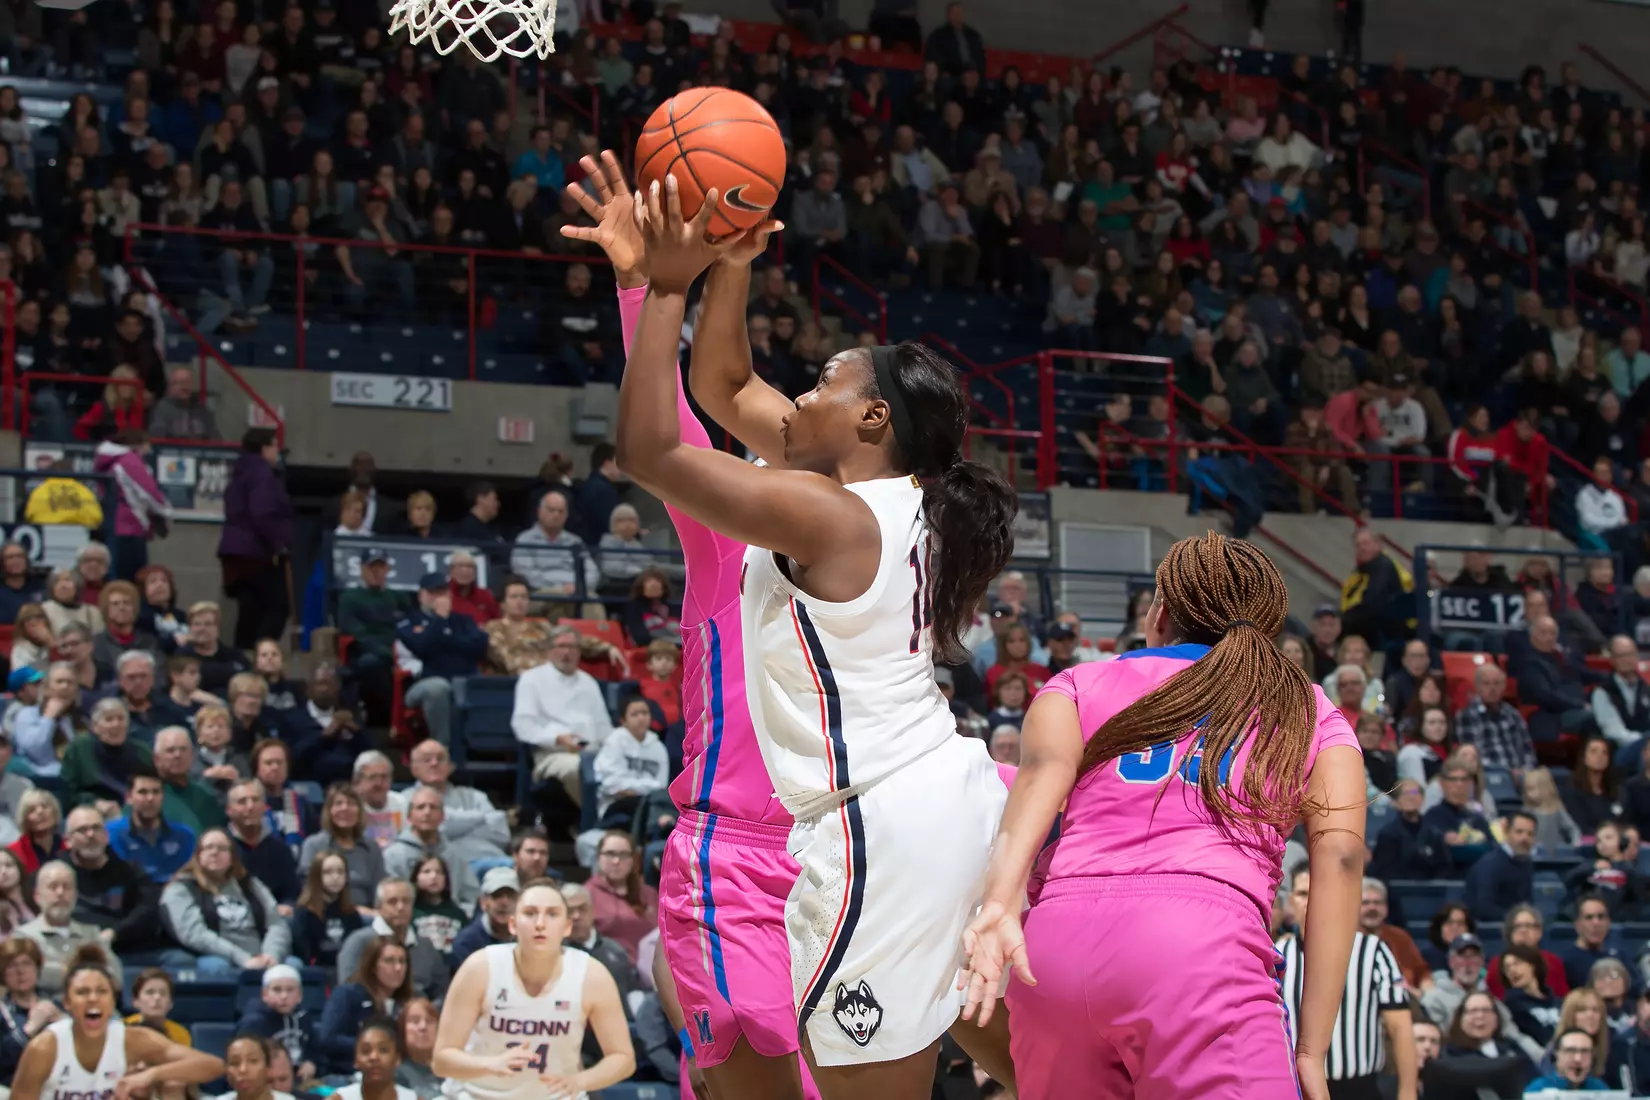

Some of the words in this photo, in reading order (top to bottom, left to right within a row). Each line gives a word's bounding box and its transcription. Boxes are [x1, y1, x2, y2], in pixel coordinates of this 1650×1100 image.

[335, 378, 375, 400] SEC
[393, 376, 450, 408] 221
[347, 556, 397, 578] SC
[1441, 596, 1480, 618] SEC
[490, 1015, 571, 1036] UCONN
